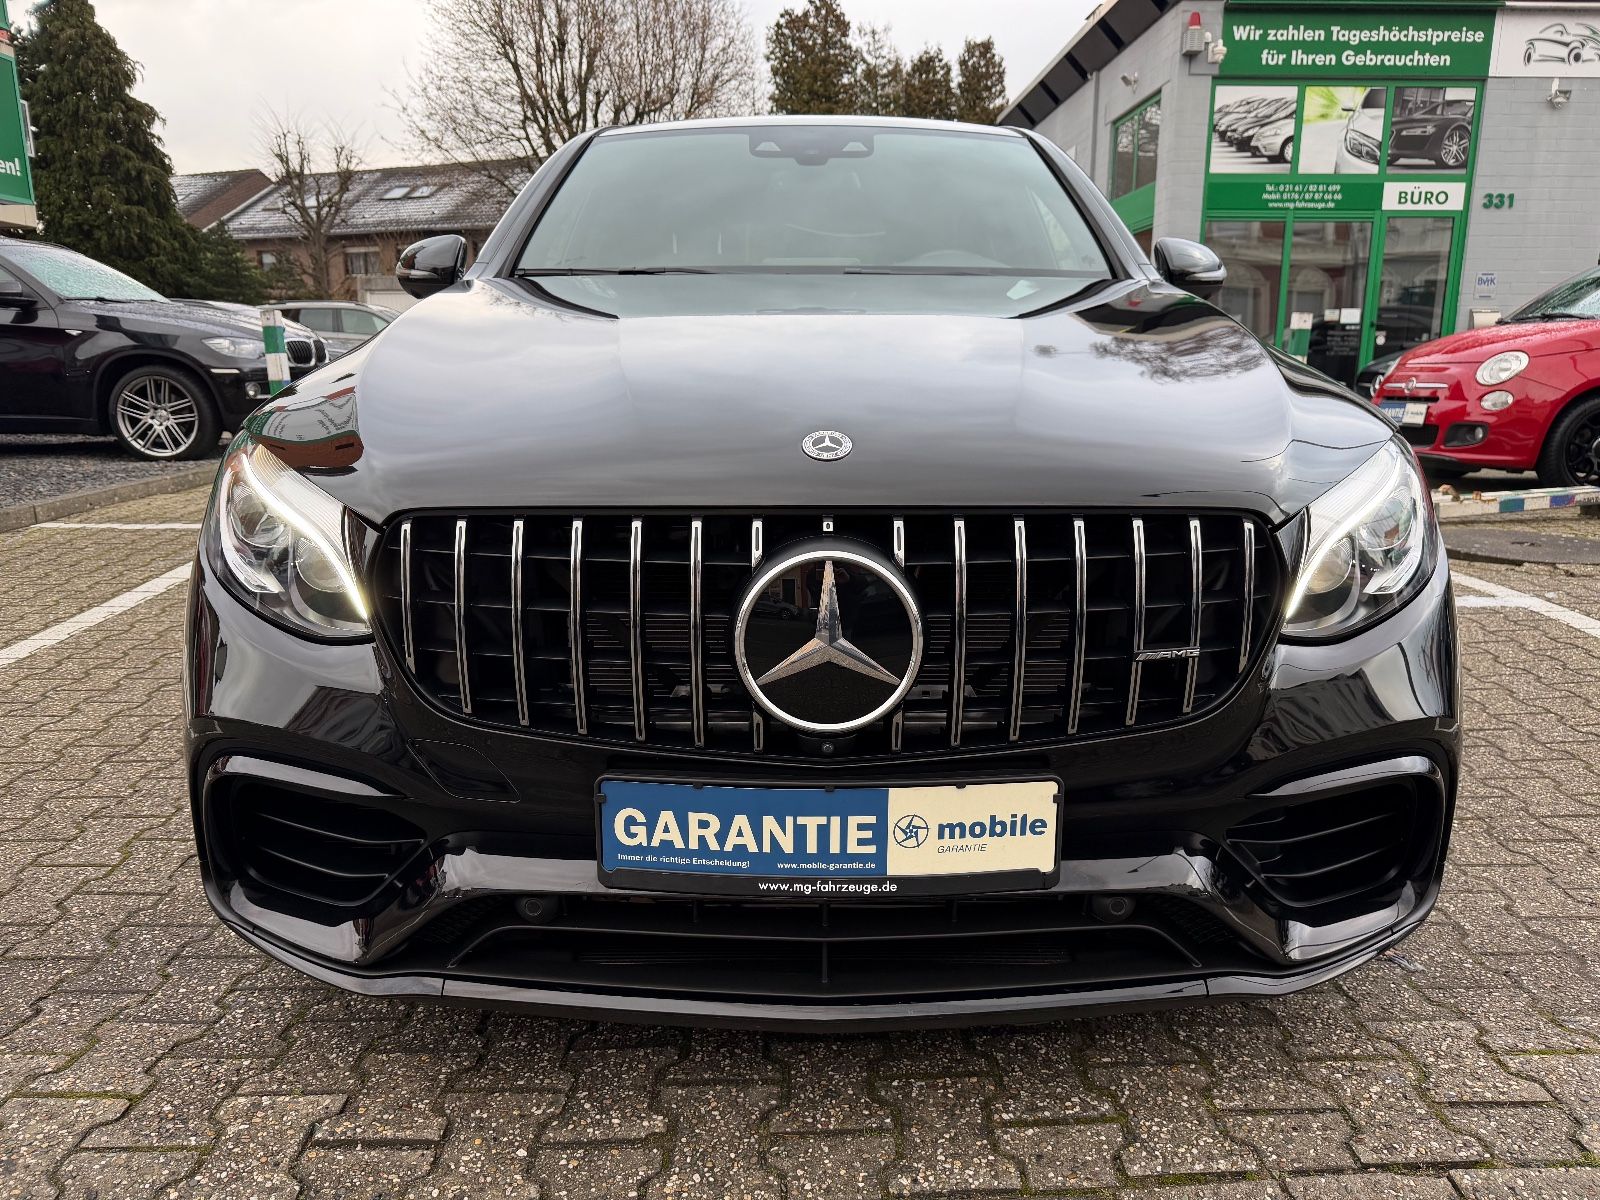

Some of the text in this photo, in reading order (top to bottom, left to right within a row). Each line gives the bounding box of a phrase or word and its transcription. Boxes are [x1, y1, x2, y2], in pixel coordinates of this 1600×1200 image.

[1233, 25, 1485, 46] Wir zahlen Tageshöchstpreise
[1261, 49, 1451, 66] für Ihren Gebrauchten
[1397, 186, 1449, 205] BÜRO
[1482, 193, 1515, 210] 331
[1158, 648, 1200, 659] AMG
[613, 807, 877, 854] GARANTIE
[937, 813, 1048, 840] mobile
[937, 843, 988, 854] GARANTIE
[617, 853, 750, 868] Immer die richtige Entscheidung!
[777, 861, 876, 870] www.mobile-garantie.de
[758, 880, 898, 894] www.mg-fahrzeuge.de
